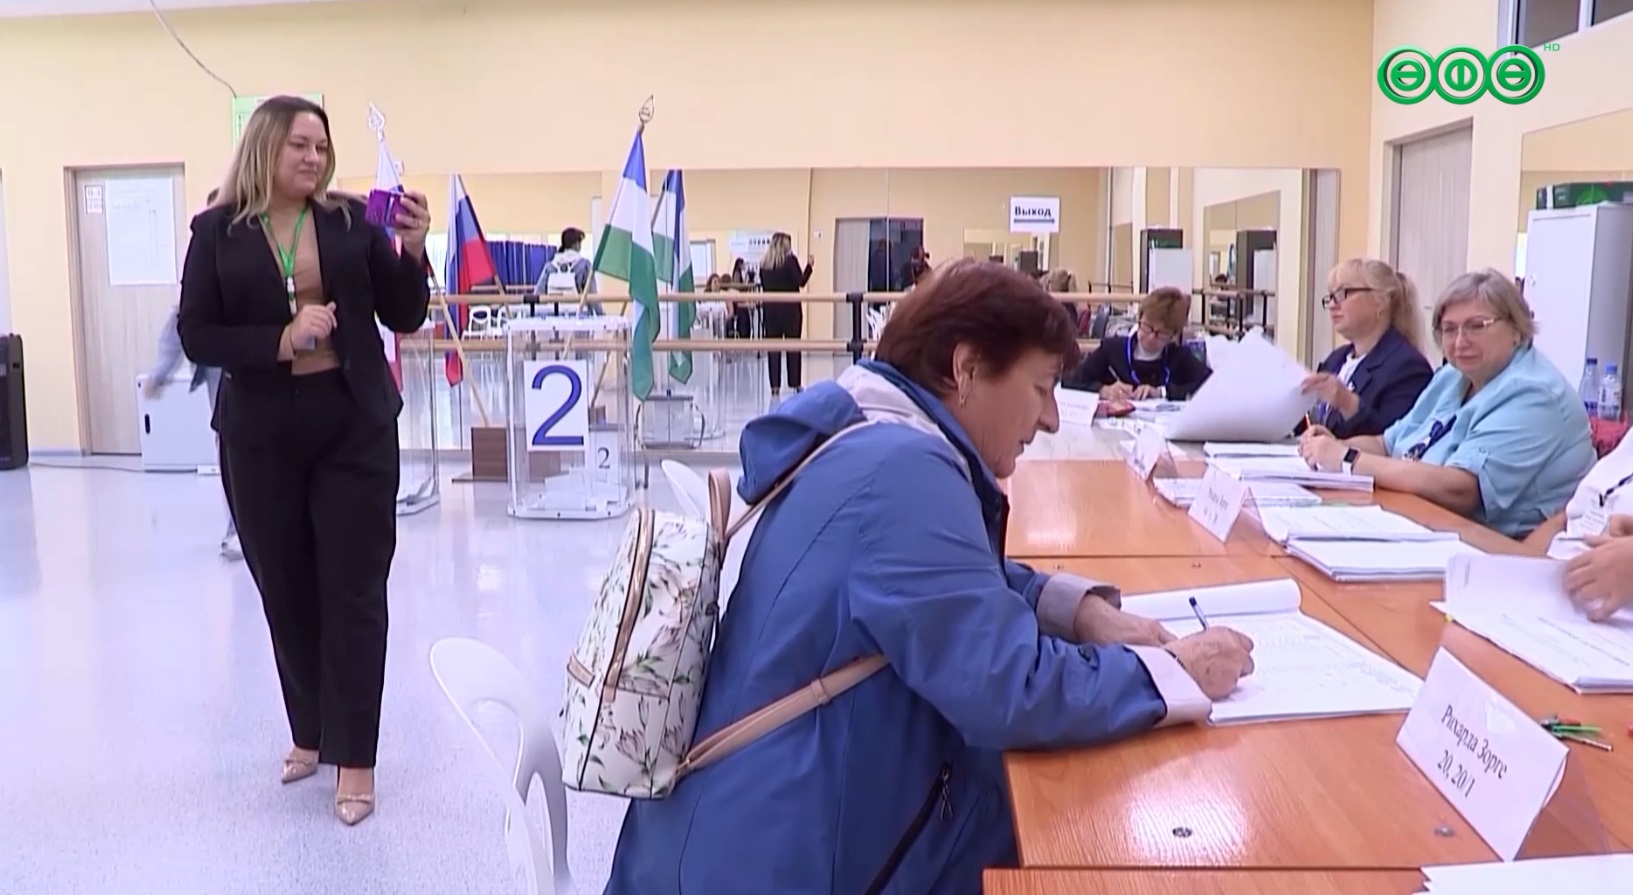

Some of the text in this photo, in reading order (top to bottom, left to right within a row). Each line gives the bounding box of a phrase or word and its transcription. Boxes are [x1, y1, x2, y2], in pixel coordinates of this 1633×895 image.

[1014, 205, 1052, 218] Выход
[532, 364, 584, 446] 2
[598, 447, 611, 469] 2
[1441, 704, 1508, 780] Рихарда Зорге
[1437, 749, 1476, 798] 20, 20/1
